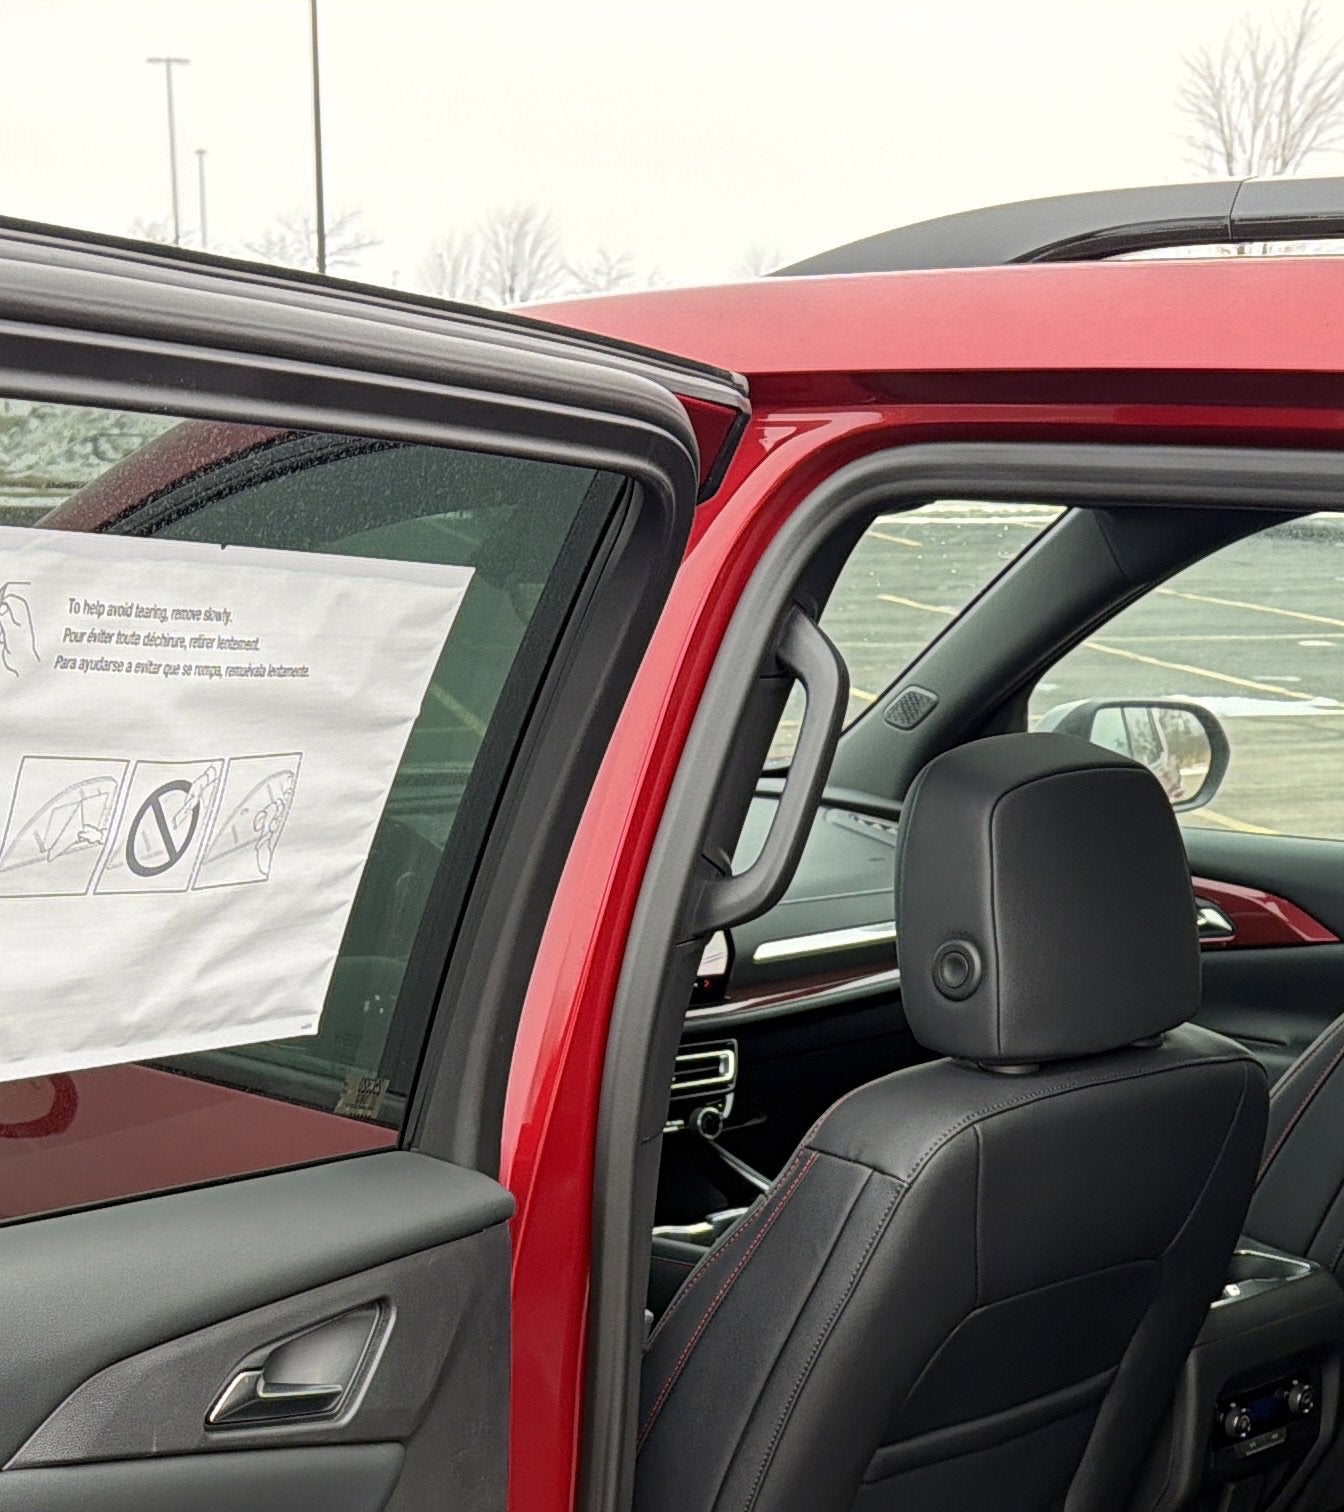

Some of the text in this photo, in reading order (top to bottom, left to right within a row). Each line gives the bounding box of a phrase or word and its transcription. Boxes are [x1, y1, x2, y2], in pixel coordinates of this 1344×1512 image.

[83, 599, 105, 619] help
[107, 602, 134, 617] avoid
[135, 603, 169, 623] tearing,
[171, 608, 202, 621] remove
[62, 627, 87, 643] Pour
[116, 630, 141, 646] toute
[54, 655, 77, 670] Para
[78, 657, 124, 673] ayudarse
[134, 660, 162, 675] evitar
[163, 663, 181, 678] que
